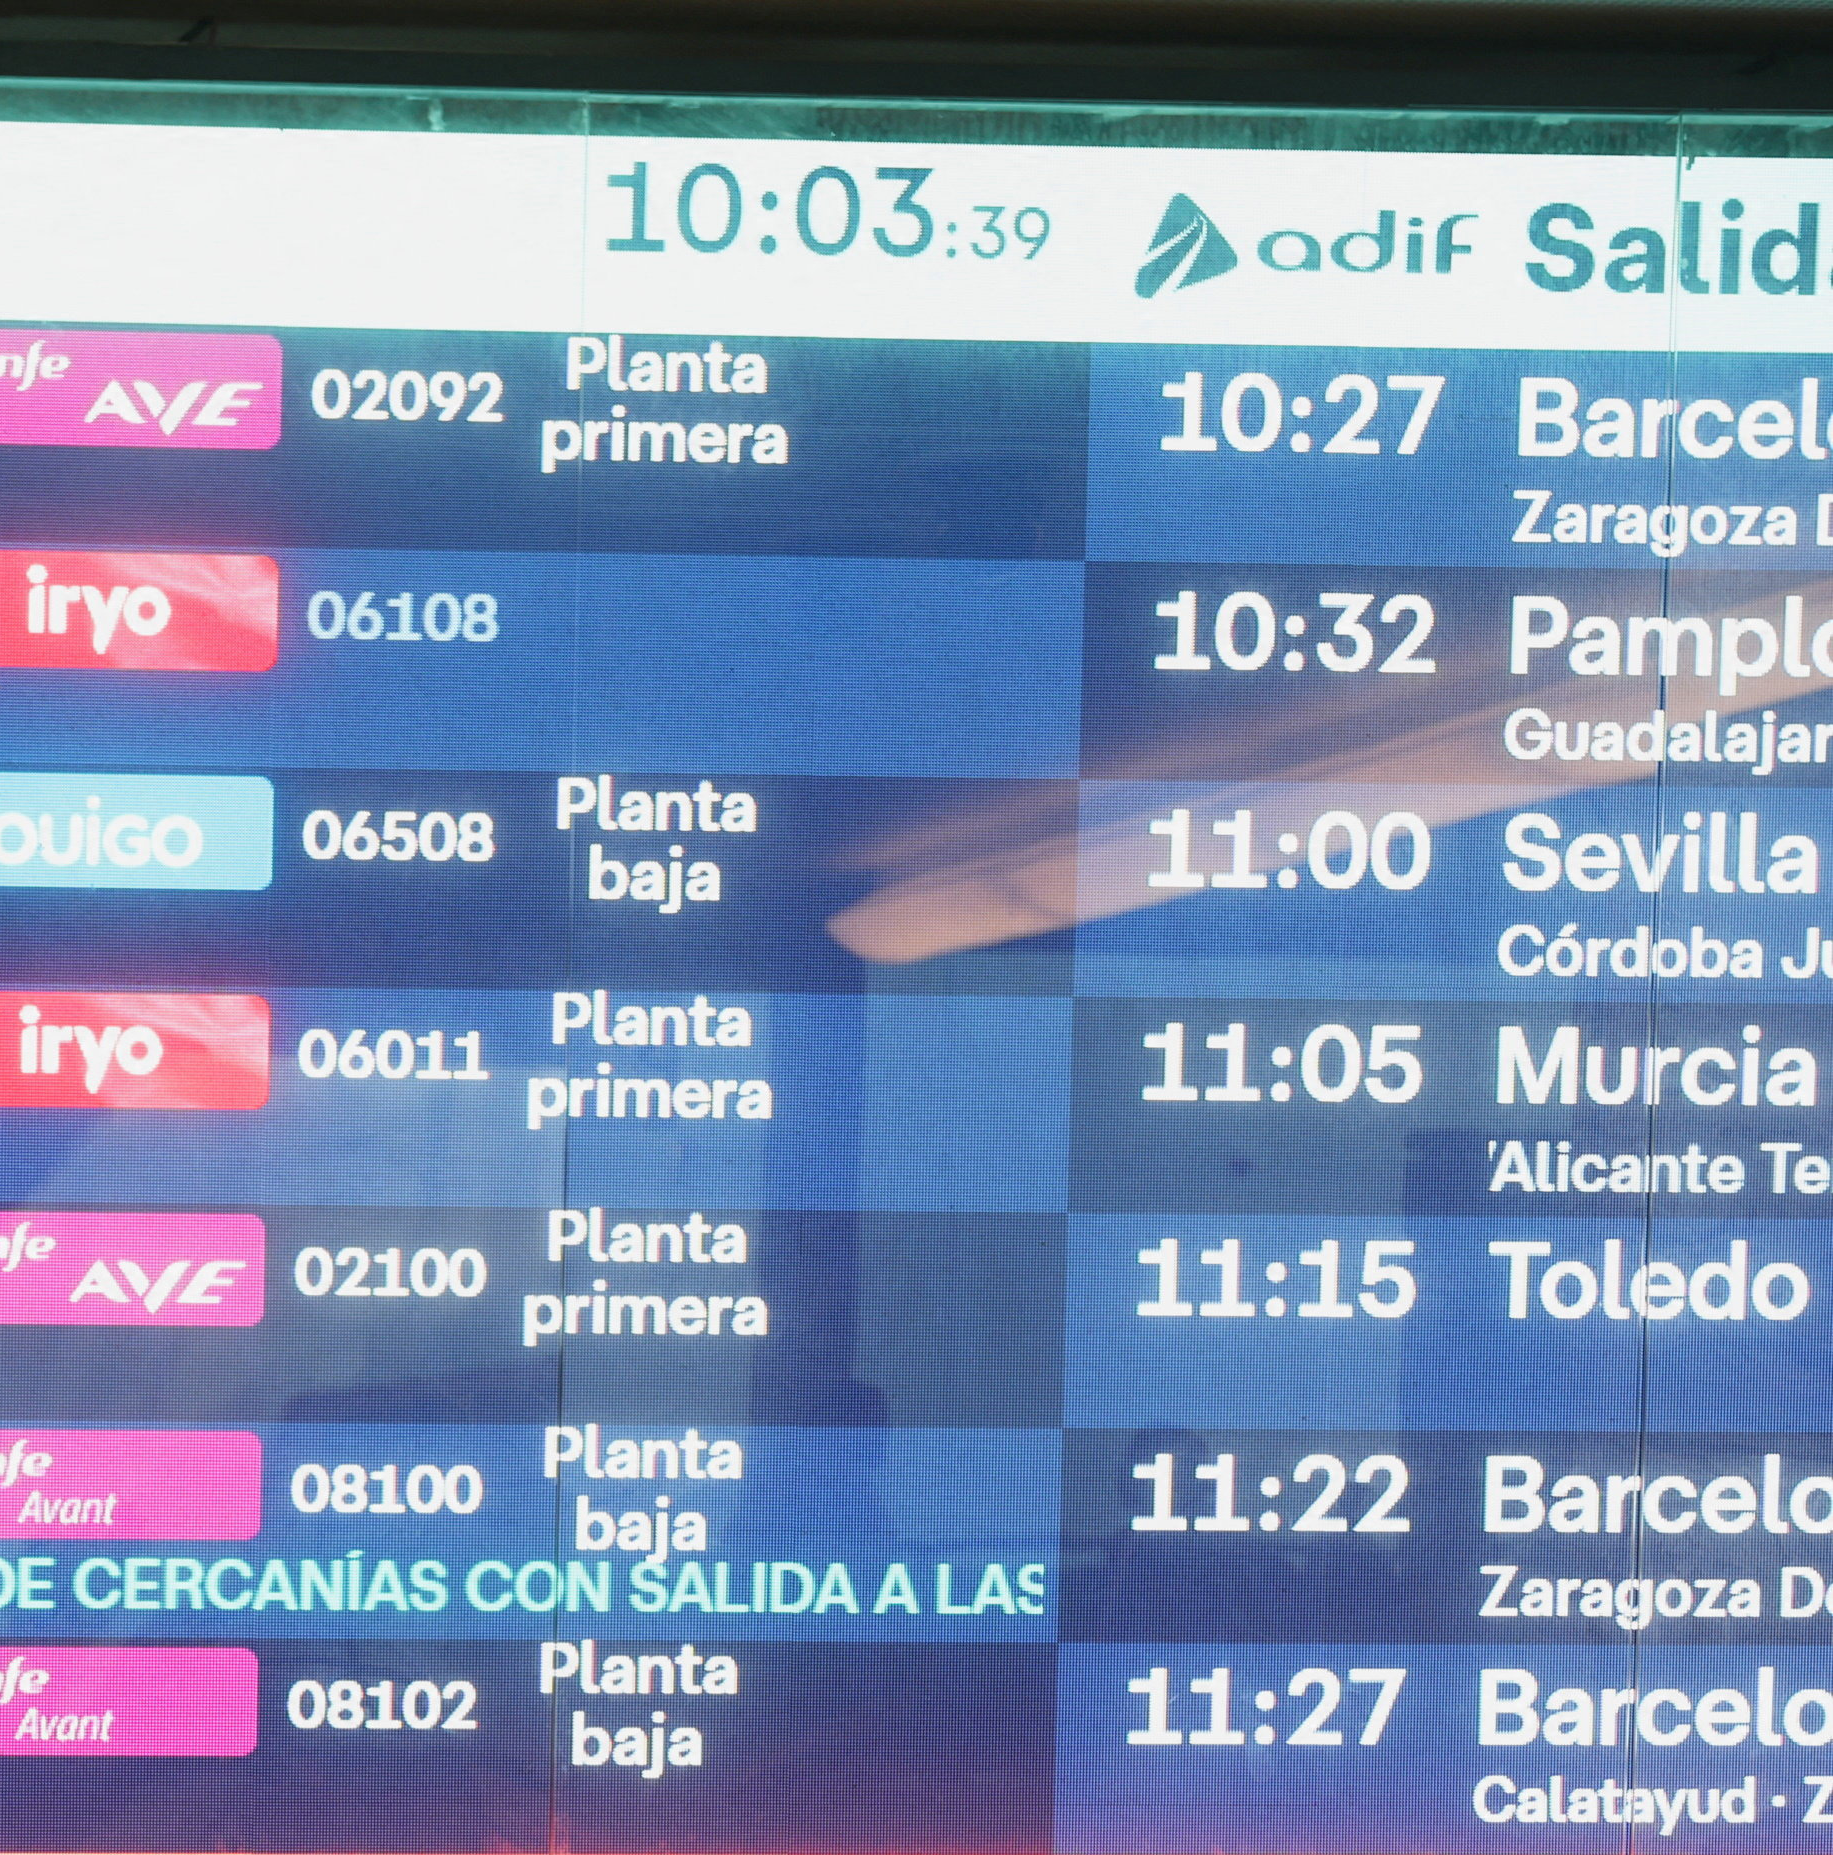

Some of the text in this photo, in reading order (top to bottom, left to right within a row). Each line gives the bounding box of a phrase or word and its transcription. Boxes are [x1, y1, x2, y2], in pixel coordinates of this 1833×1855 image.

[1256, 199, 1833, 296] adif Salid
[311, 368, 504, 423] 02092
[565, 335, 769, 394] Planta
[84, 378, 264, 436] AVE
[541, 404, 788, 474] primera
[1161, 371, 1446, 455] 10:27
[1519, 376, 1833, 460] Barcel
[1512, 489, 1798, 558] Zaragoza
[27, 564, 172, 654] iryo
[307, 590, 498, 642] 06108
[1155, 590, 1437, 674] 10:32
[303, 810, 495, 862] 06508
[556, 774, 758, 833] Planta
[589, 843, 721, 914] baja
[1146, 808, 1432, 891] 11:00
[1503, 811, 1819, 894] Sevilla
[1497, 923, 1764, 979] Córdoba
[19, 1005, 163, 1094] iryo
[552, 989, 753, 1047] Planta
[297, 1028, 491, 1081] 06011
[1143, 1022, 1423, 1104] 11:05
[1497, 1025, 1817, 1107] Murcia
[527, 1061, 773, 1131] primera
[1760, 1142, 1832, 1194] Te
[548, 1206, 747, 1264] Planta
[69, 1258, 247, 1315] AVE
[294, 1246, 488, 1298] 02100
[1135, 1237, 1417, 1319] 11:15
[1487, 1238, 1810, 1321] Toledo
[523, 1278, 768, 1347] primera
[544, 1422, 743, 1480] Planta
[16, 1488, 119, 1526] Avant
[291, 1463, 484, 1514] 08100
[1133, 1453, 1410, 1533] 11:22
[574, 1495, 708, 1563] baja
[73, 1549, 449, 1612] CERCANÍAS
[465, 1559, 611, 1613] CON
[629, 1562, 860, 1614] SALIDA
[873, 1563, 919, 1614] A
[1479, 1565, 1833, 1631] Zaragoza D
[540, 1639, 738, 1695] Planta
[14, 1706, 115, 1743] Avant
[287, 1680, 477, 1730] 08102
[1127, 1667, 1407, 1746] 11:27
[572, 1710, 703, 1779] baja
[1473, 1774, 1756, 1837] Calatayud
